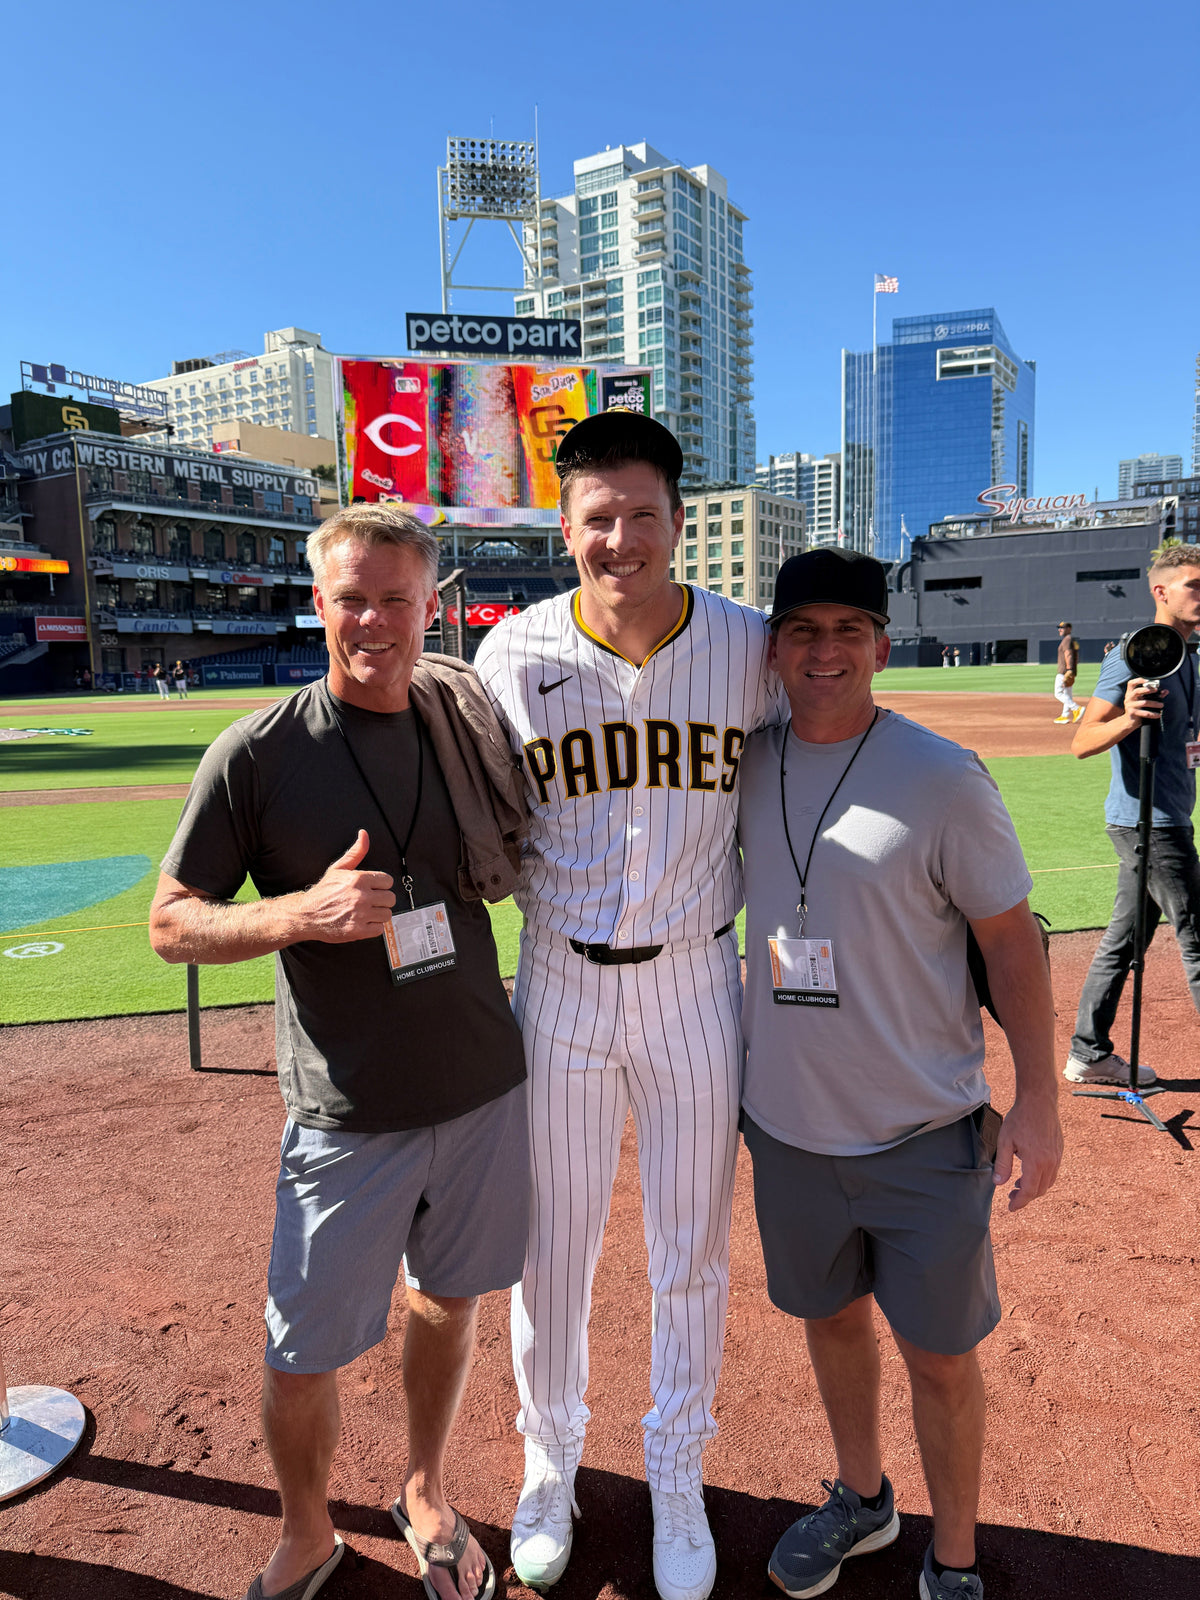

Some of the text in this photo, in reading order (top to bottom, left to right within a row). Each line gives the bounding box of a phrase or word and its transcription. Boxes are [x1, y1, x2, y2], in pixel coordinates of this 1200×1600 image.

[409, 316, 579, 352] petco park
[950, 322, 990, 334] SEMPRA
[532, 374, 577, 401] San Diego
[608, 392, 645, 407] petco
[77, 443, 318, 498] WESTERN METAL SUPPLY CO.
[975, 484, 1091, 524] Sycuan
[136, 566, 170, 579] ORIS
[100, 634, 119, 645] 336
[220, 670, 260, 680] Palomar
[522, 718, 746, 805] PADRES
[396, 959, 455, 981] HOME CLUBHOUSE
[797, 995, 836, 1004] CLUBHOUSE
